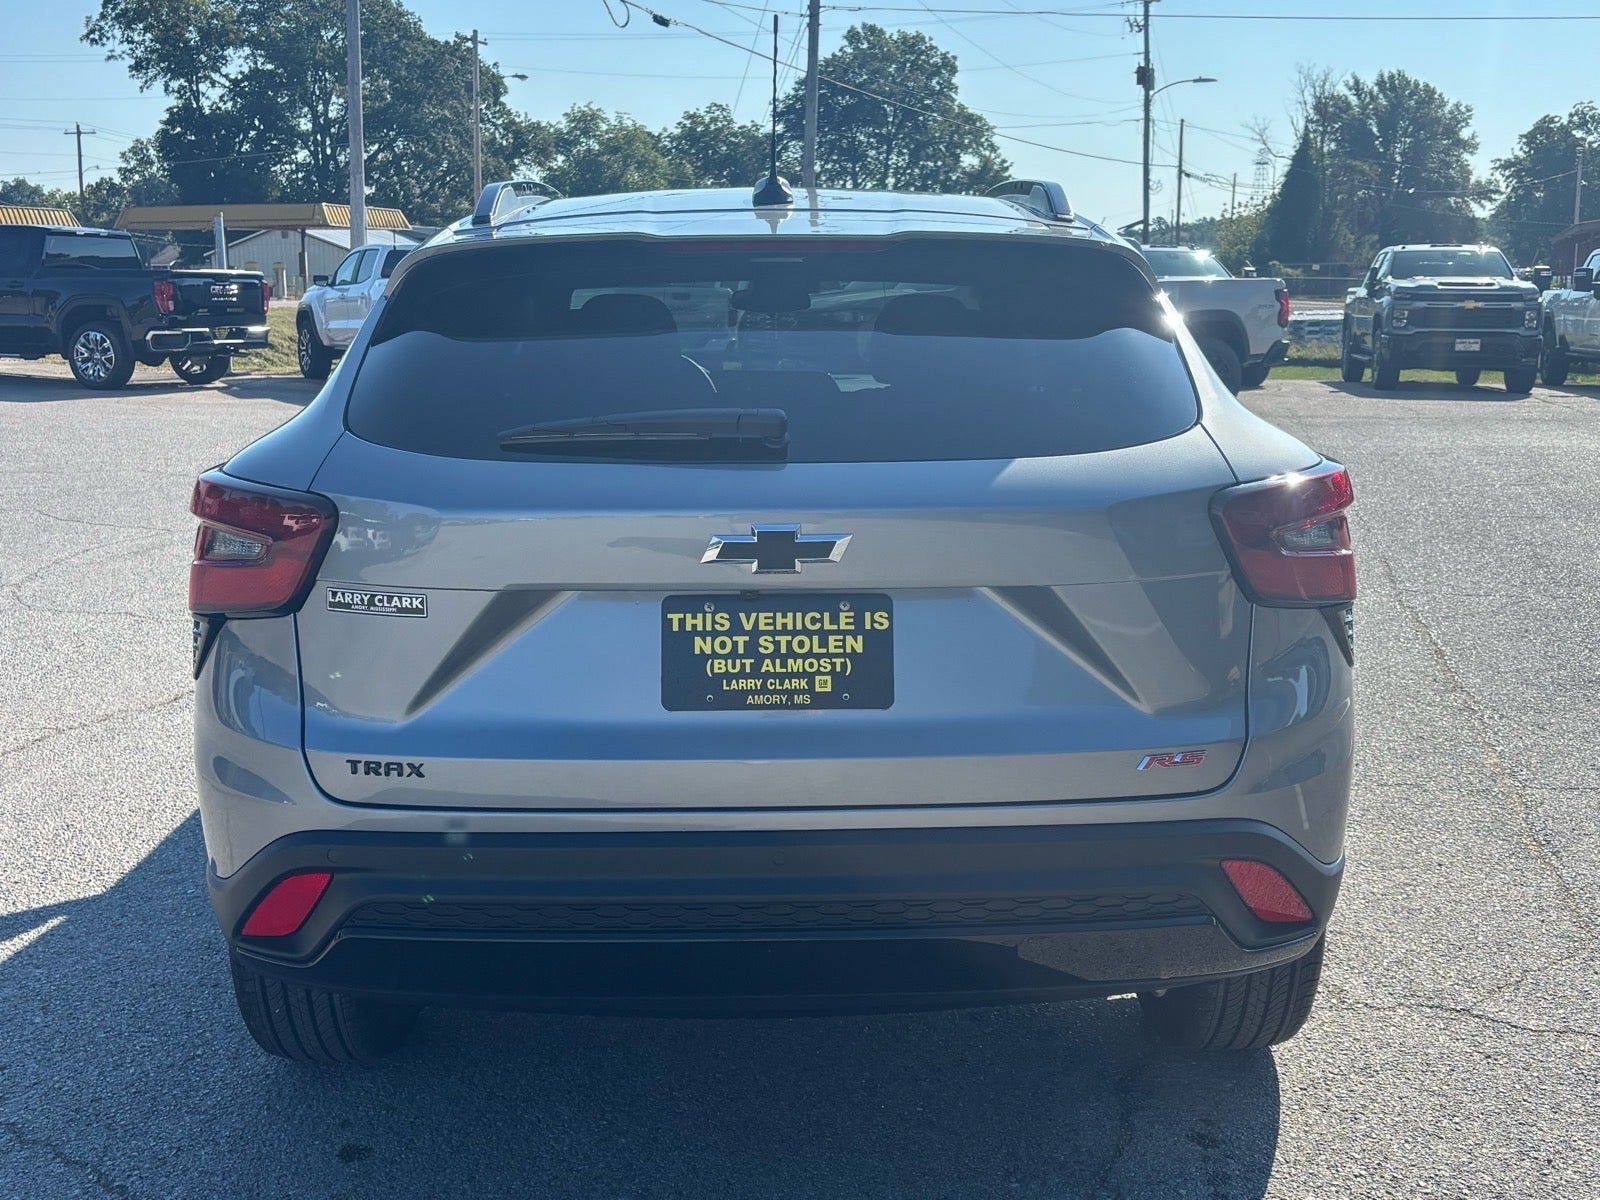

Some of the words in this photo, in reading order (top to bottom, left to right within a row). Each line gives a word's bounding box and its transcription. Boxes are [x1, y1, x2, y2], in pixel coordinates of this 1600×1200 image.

[328, 591, 370, 605] LARRY
[374, 595, 423, 609] CLARK
[667, 612, 730, 632] THIS
[739, 611, 855, 631] VEHICLE
[864, 611, 890, 630] IS
[694, 636, 749, 654] NOT
[758, 635, 864, 654] STOLEN
[706, 658, 755, 677] (BUT
[760, 657, 852, 676] ALMOST)
[722, 679, 763, 690] LARRY
[767, 678, 809, 690] CLARK
[817, 678, 829, 688] GM
[746, 694, 791, 706] AMORY,
[794, 694, 811, 705] MS
[345, 759, 426, 778] TRAX
[1136, 750, 1208, 771] RS
